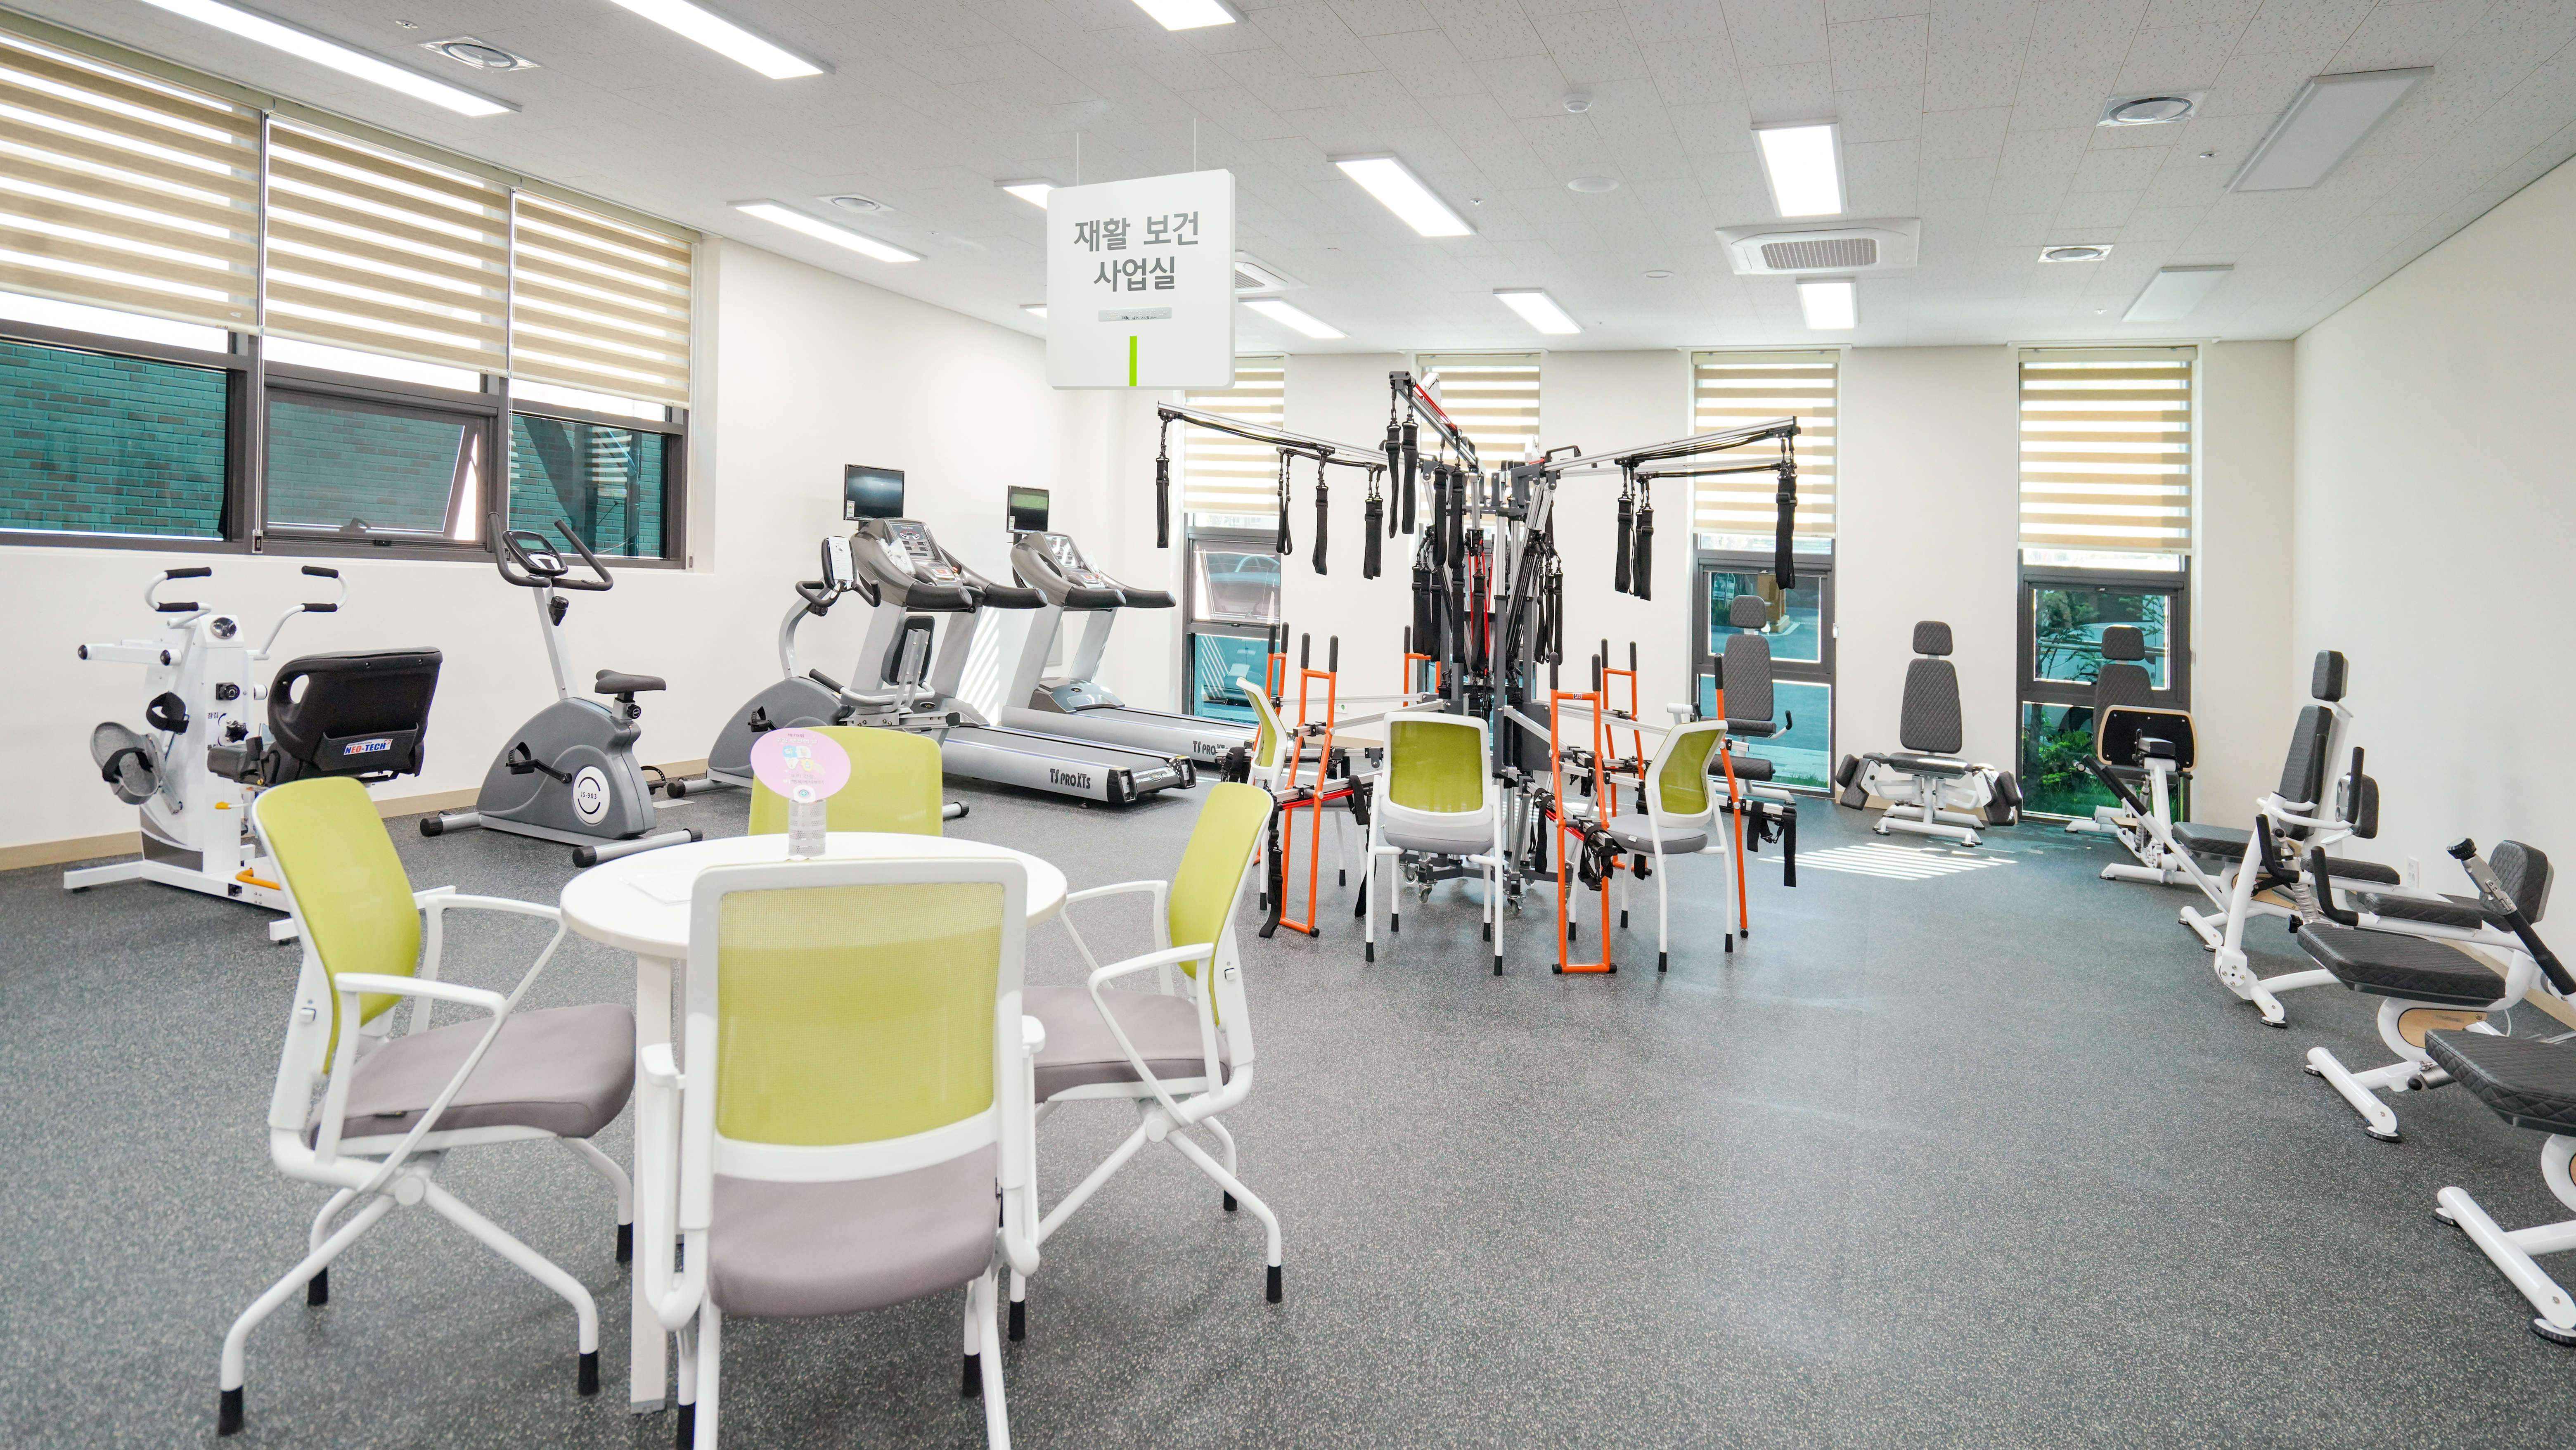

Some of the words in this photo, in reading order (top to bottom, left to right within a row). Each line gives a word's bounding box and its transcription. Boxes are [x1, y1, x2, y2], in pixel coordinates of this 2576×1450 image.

[1074, 218, 1130, 252] 재활
[1144, 211, 1198, 245] 보건
[1094, 256, 1174, 292] 사업실
[345, 743, 386, 754] NEO-TECH
[1193, 740, 1201, 753] TS
[1050, 768, 1059, 784] TS
